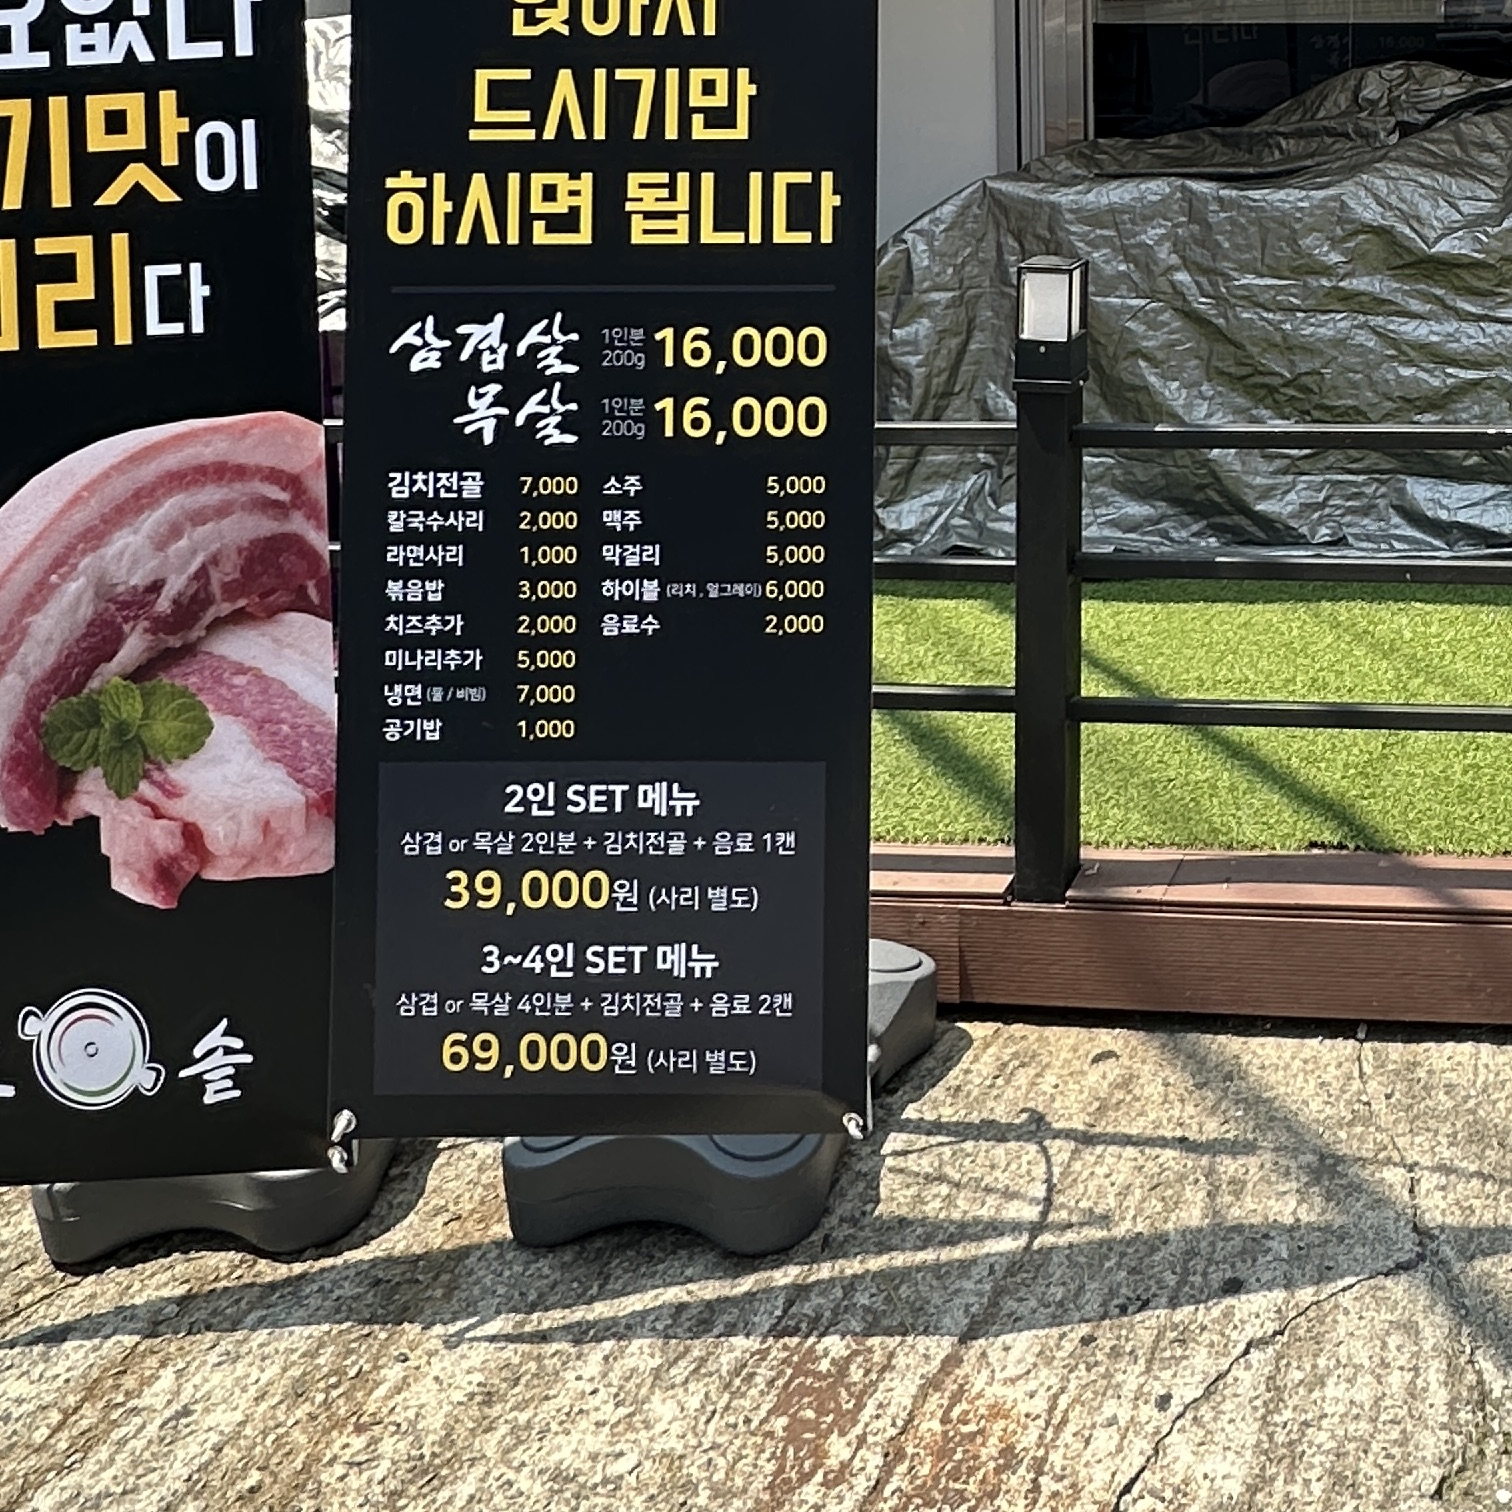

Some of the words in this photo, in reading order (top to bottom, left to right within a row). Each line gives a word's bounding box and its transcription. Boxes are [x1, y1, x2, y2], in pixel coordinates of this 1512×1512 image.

[469, 68, 757, 140] 드시기만
[385, 171, 593, 245] 하시면
[625, 171, 841, 244] 됩니다
[0, 233, 210, 352] 리다
[389, 312, 579, 375] 삼겹살
[602, 327, 645, 346] 1인분
[602, 350, 645, 369] 200g
[655, 327, 827, 374] 16,000
[453, 382, 578, 445] 목살
[601, 398, 645, 416] 1인분
[602, 420, 645, 439] 200g
[654, 397, 827, 445] 16,000
[388, 471, 484, 498] 김치전골
[520, 477, 577, 497] 7,000
[603, 476, 643, 496] 소주
[767, 476, 825, 497] 5,000
[388, 510, 483, 532] 칼국수사리
[519, 511, 577, 531] 2,000
[603, 510, 642, 531] 맥주
[767, 511, 825, 531] 5,000
[387, 545, 463, 566] 라면사리
[521, 546, 577, 566] 1,000
[603, 544, 659, 566] 막걸리
[767, 545, 825, 566] 5,000
[385, 579, 444, 601] 볶음밥
[519, 581, 576, 601] 3,000
[602, 579, 660, 601] 하이볼
[766, 581, 824, 601] 6,000
[385, 614, 464, 635] 치즈추가
[517, 615, 576, 635] 2,000
[601, 614, 660, 635] 음료수
[765, 615, 823, 635] 2,000
[385, 649, 483, 670] 미나리추가
[518, 650, 575, 670] 5,000
[385, 684, 421, 706] 냉면
[517, 685, 575, 705] 7,000
[383, 719, 442, 741] 공기밥
[518, 720, 574, 740] 1,000
[505, 782, 555, 816] 2인
[567, 785, 629, 813] SET
[638, 782, 700, 816] 메뉴
[401, 831, 442, 855] 삼겹
[449, 839, 468, 851] or
[473, 831, 515, 854] 목살
[521, 831, 577, 854] 2인분
[604, 831, 687, 855] 김치전골
[713, 832, 754, 855] 음료
[763, 831, 795, 854] 1캔
[649, 886, 699, 911] (사리
[708, 887, 758, 911] 별도)
[481, 943, 573, 977] 3~4인
[586, 945, 648, 973] SET
[657, 943, 719, 978] 메뉴
[396, 992, 437, 1016] 삼겹
[445, 1000, 464, 1013] or
[469, 992, 512, 1016] 목살
[517, 993, 573, 1015] 4인분
[601, 993, 683, 1017] 김치전골
[710, 993, 751, 1017] 음료
[759, 993, 792, 1016] 2캔
[648, 1049, 697, 1073] (사리
[706, 1050, 755, 1075] 별도)
